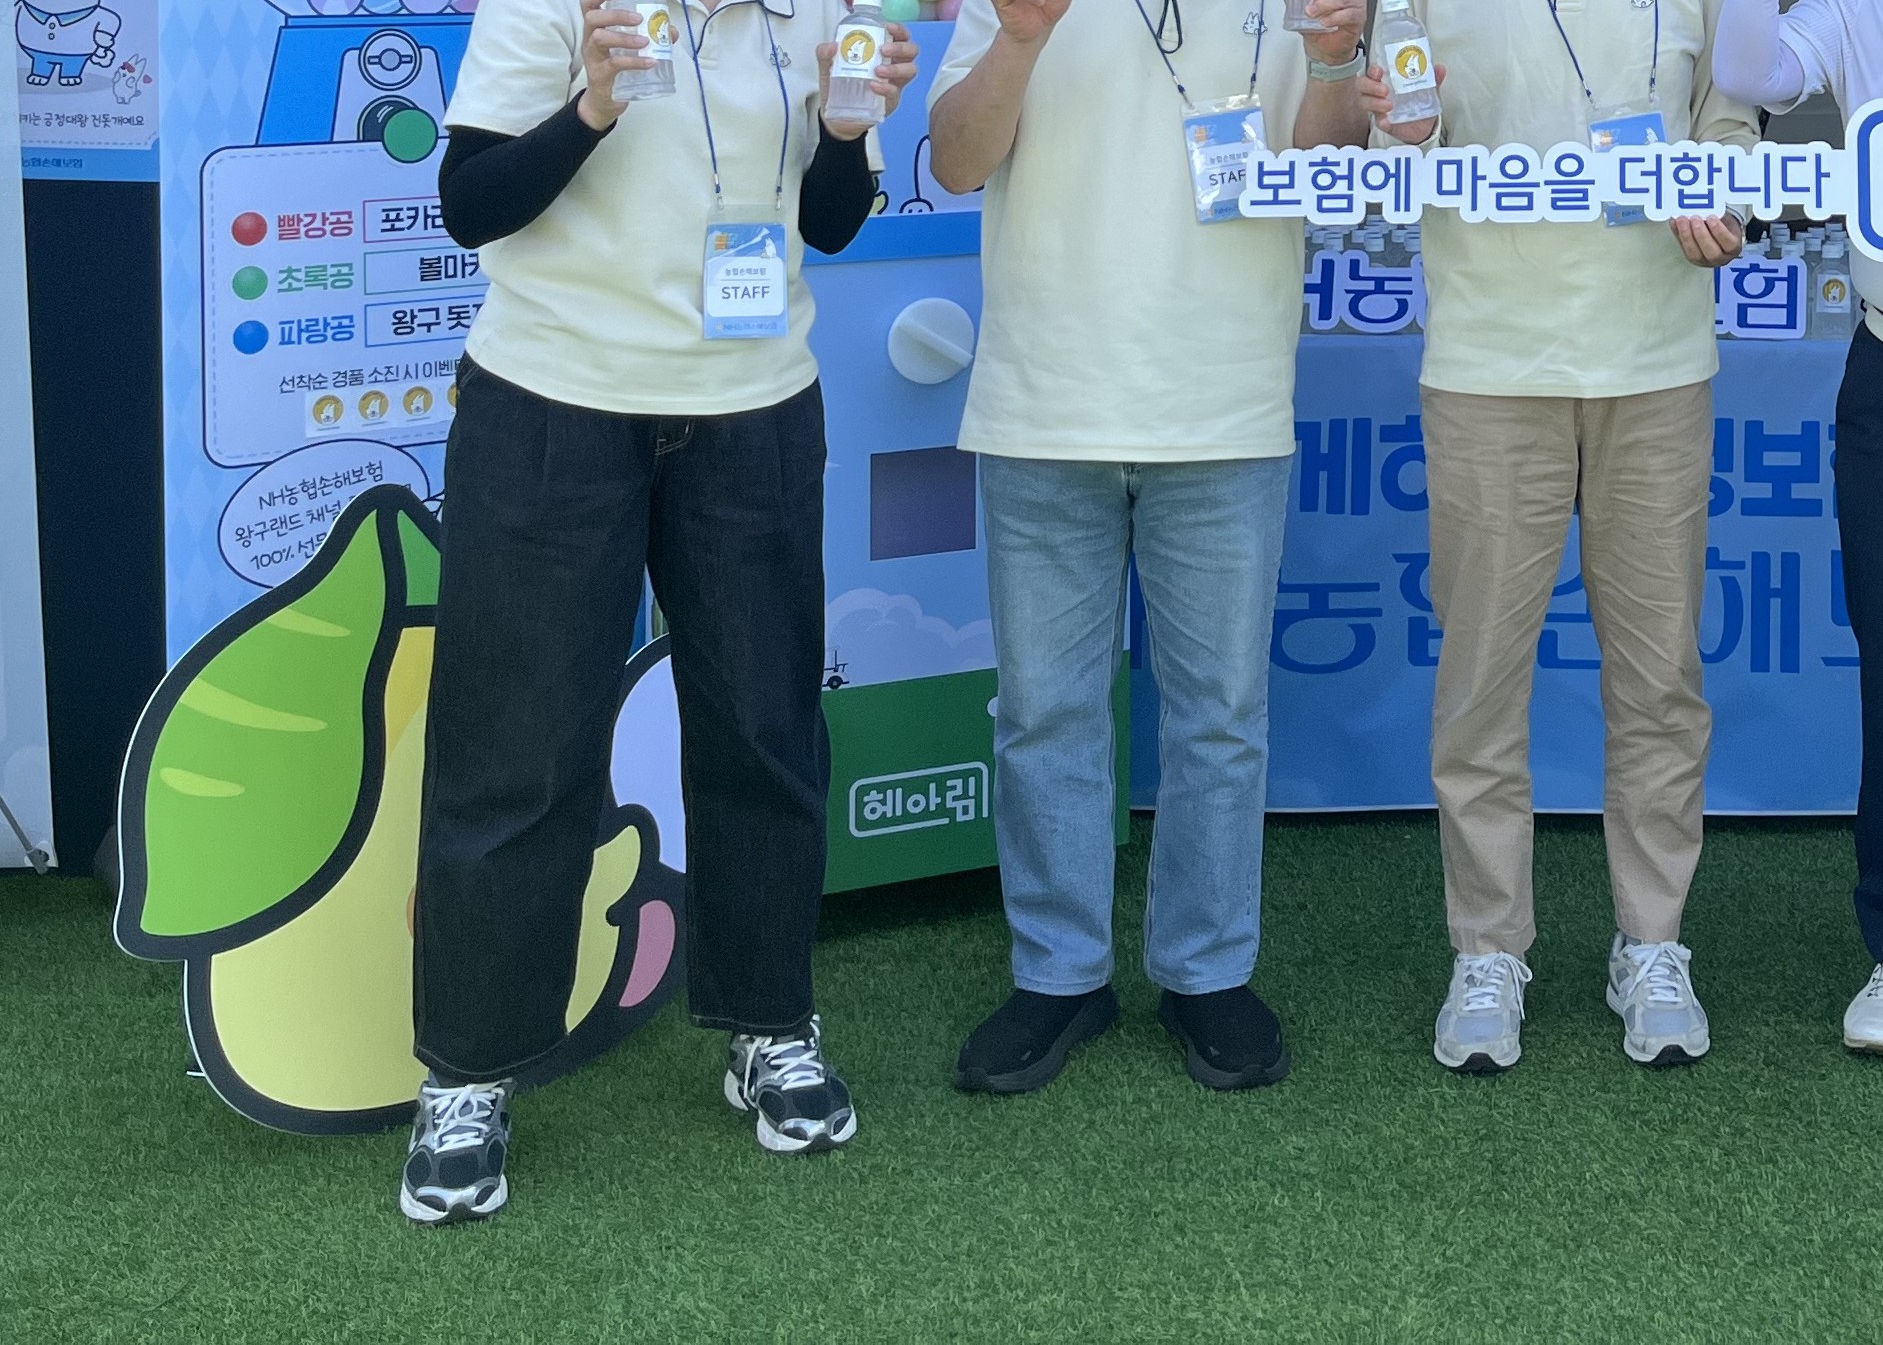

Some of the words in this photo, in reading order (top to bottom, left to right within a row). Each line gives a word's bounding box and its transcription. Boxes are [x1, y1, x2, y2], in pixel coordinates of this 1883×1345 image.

[1208, 168, 1247, 187] STAF
[1249, 156, 1411, 214] 보험에
[1436, 153, 1596, 211] 마음을
[1619, 150, 1831, 210] 더합니다
[277, 210, 354, 241] 빨강공
[277, 262, 354, 294] 초록공
[721, 285, 771, 300] STAFF
[278, 314, 355, 347] 파랑공
[391, 307, 441, 337] 왕구
[446, 303, 485, 332] 돗
[279, 372, 328, 394] 선착순
[332, 368, 365, 388] 경품
[367, 364, 400, 385] 소진
[403, 362, 420, 380] 시
[422, 358, 461, 379] 이벤
[258, 460, 384, 510] NH농협손해보험
[235, 512, 304, 548] 왕구랜드
[250, 545, 295, 570] 100%
[863, 776, 976, 822] 헤아림
